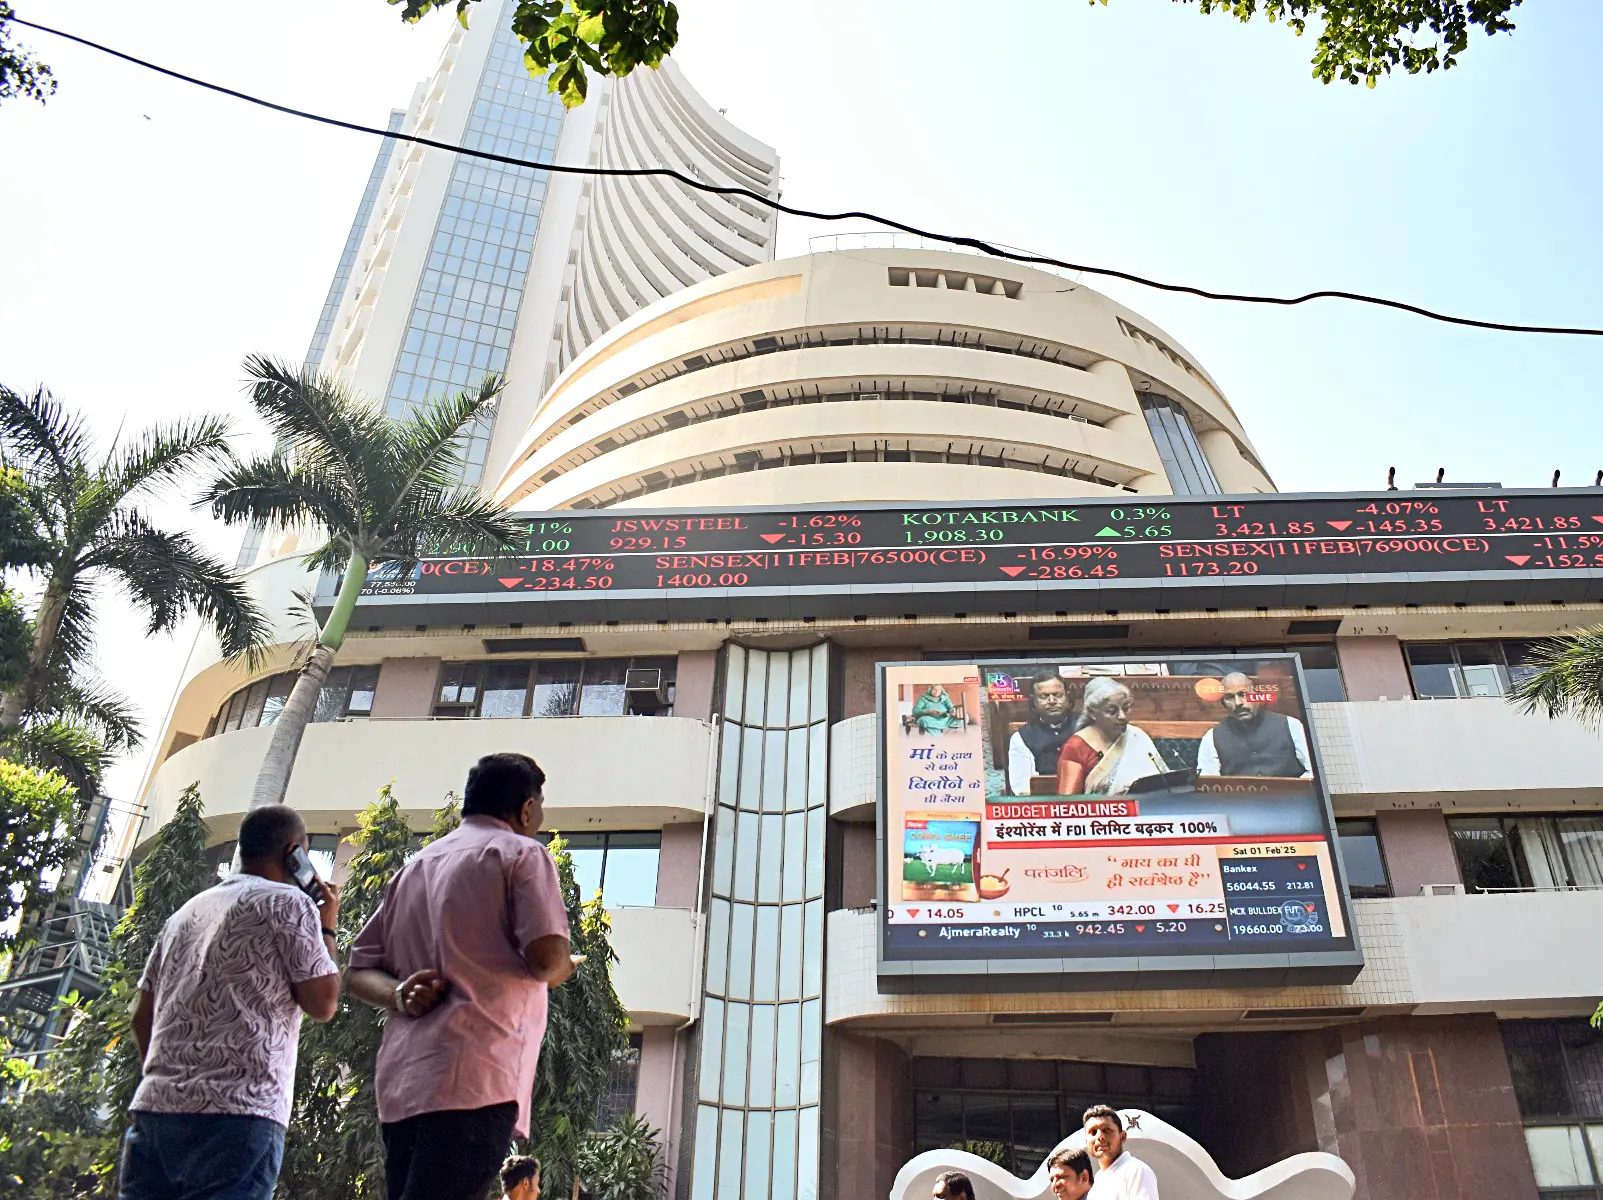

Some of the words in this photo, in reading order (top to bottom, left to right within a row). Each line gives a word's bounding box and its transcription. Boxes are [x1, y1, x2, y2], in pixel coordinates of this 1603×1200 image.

[611, 517, 748, 533] JSWSTEEL
[778, 514, 862, 529] -1.62%
[901, 509, 1082, 525] KOTAKBANK
[1110, 508, 1171, 521] 0.3%
[1212, 505, 1244, 519] LT
[1357, 501, 1439, 515] -4.07%
[1477, 500, 1510, 514] LT
[610, 535, 687, 549] 929.15
[788, 532, 862, 545] -15.30
[905, 529, 1004, 545] 1,908.30
[1123, 525, 1173, 539] 5.65
[1216, 521, 1316, 537] 3,421.85
[1357, 518, 1443, 533] -145.35
[1484, 515, 1581, 532] 3,421.85
[521, 557, 615, 572] -18.47%
[1018, 546, 1118, 561] -16.99%
[525, 575, 614, 591] -234.50
[658, 573, 749, 587] 1400.00
[1028, 563, 1120, 580] -286.45
[1165, 561, 1258, 577] 1173.20
[1249, 693, 1273, 702] LIVE
[935, 750, 948, 760] के
[951, 752, 972, 761] हाथ
[924, 761, 936, 771] से
[938, 761, 959, 771] बने
[968, 780, 981, 789] के
[940, 793, 966, 804] जैसा
[992, 804, 1048, 818] BUDGET
[1050, 801, 1128, 817] HEADLINES
[1051, 821, 1062, 837] में
[1066, 825, 1086, 836] FDI
[1090, 820, 1131, 836] लिमिट
[1179, 821, 1218, 834] 100%
[1232, 847, 1248, 855] Sat
[1250, 847, 1262, 855] 01
[1156, 858, 1179, 868] का
[1183, 853, 1201, 867] घी
[1024, 864, 1086, 880] पतंजलि
[1223, 864, 1258, 873] Bankex
[1106, 872, 1124, 889] ही
[1226, 881, 1276, 891] 56044.55
[1286, 881, 1315, 890] 212.81
[926, 908, 965, 919] 14.05
[1014, 907, 1046, 917] HPCL
[1107, 905, 1156, 916] 342.00
[1188, 903, 1225, 914] 16.25
[1229, 907, 1246, 916] MCX
[1247, 906, 1283, 915] BULLDEX
[1284, 906, 1300, 914] FUT
[939, 926, 1021, 939] AjmeraRealty
[1075, 924, 1125, 935] 942.45
[1156, 922, 1187, 933] 5.20
[1233, 924, 1283, 935] 19660.00
